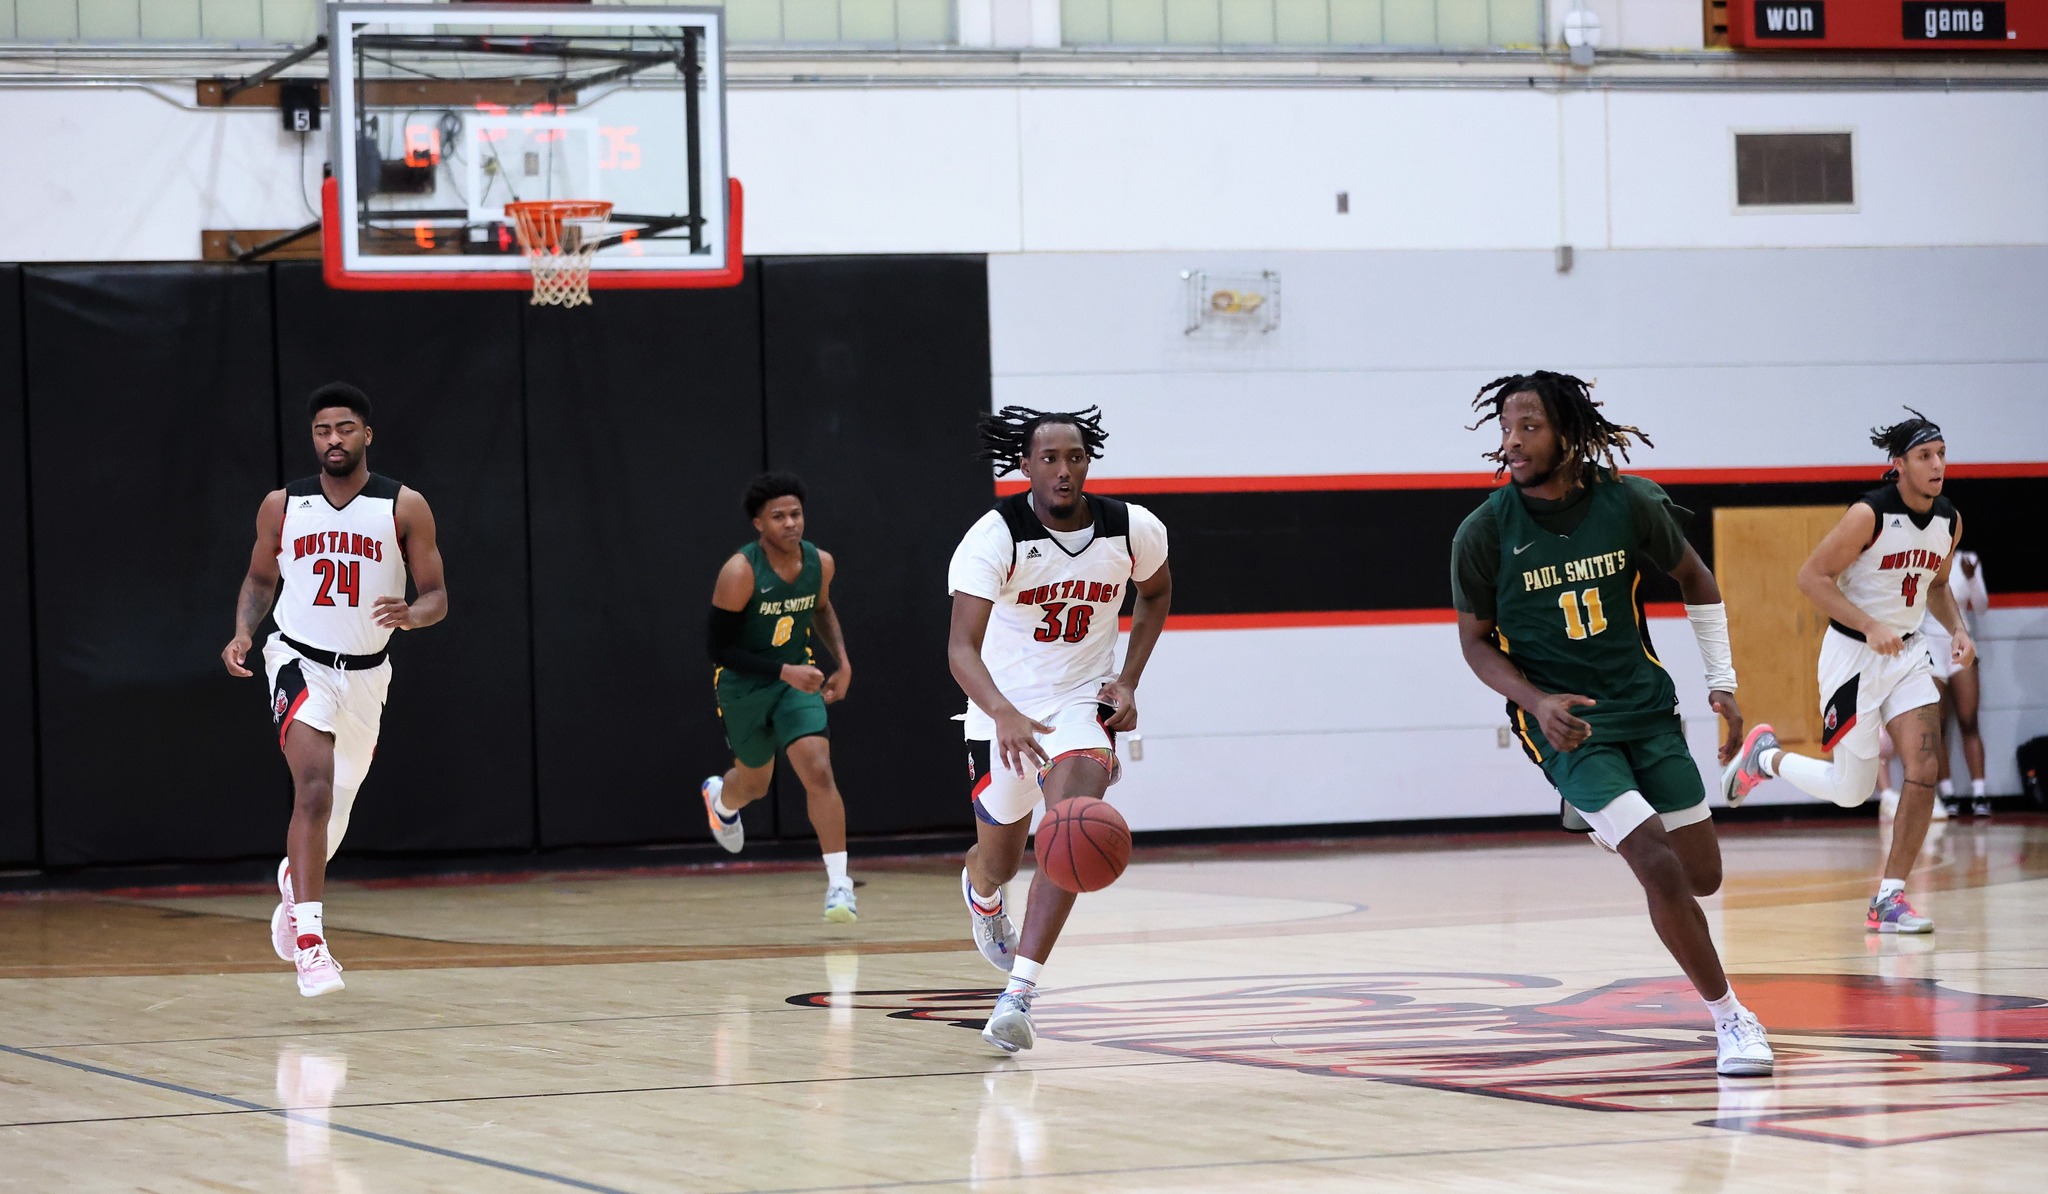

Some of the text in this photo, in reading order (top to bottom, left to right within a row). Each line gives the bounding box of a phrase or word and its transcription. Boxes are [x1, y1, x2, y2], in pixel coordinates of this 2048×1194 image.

[1766, 7, 1814, 31] won
[1925, 8, 1984, 38] game
[298, 112, 308, 129] 5
[293, 531, 383, 563] MUSTANGS
[312, 558, 360, 607] 24
[1522, 549, 1626, 592] PAUL SMITH'S
[1901, 572, 1922, 607] 4
[1033, 602, 1094, 643] 30
[1558, 586, 1608, 640] 11
